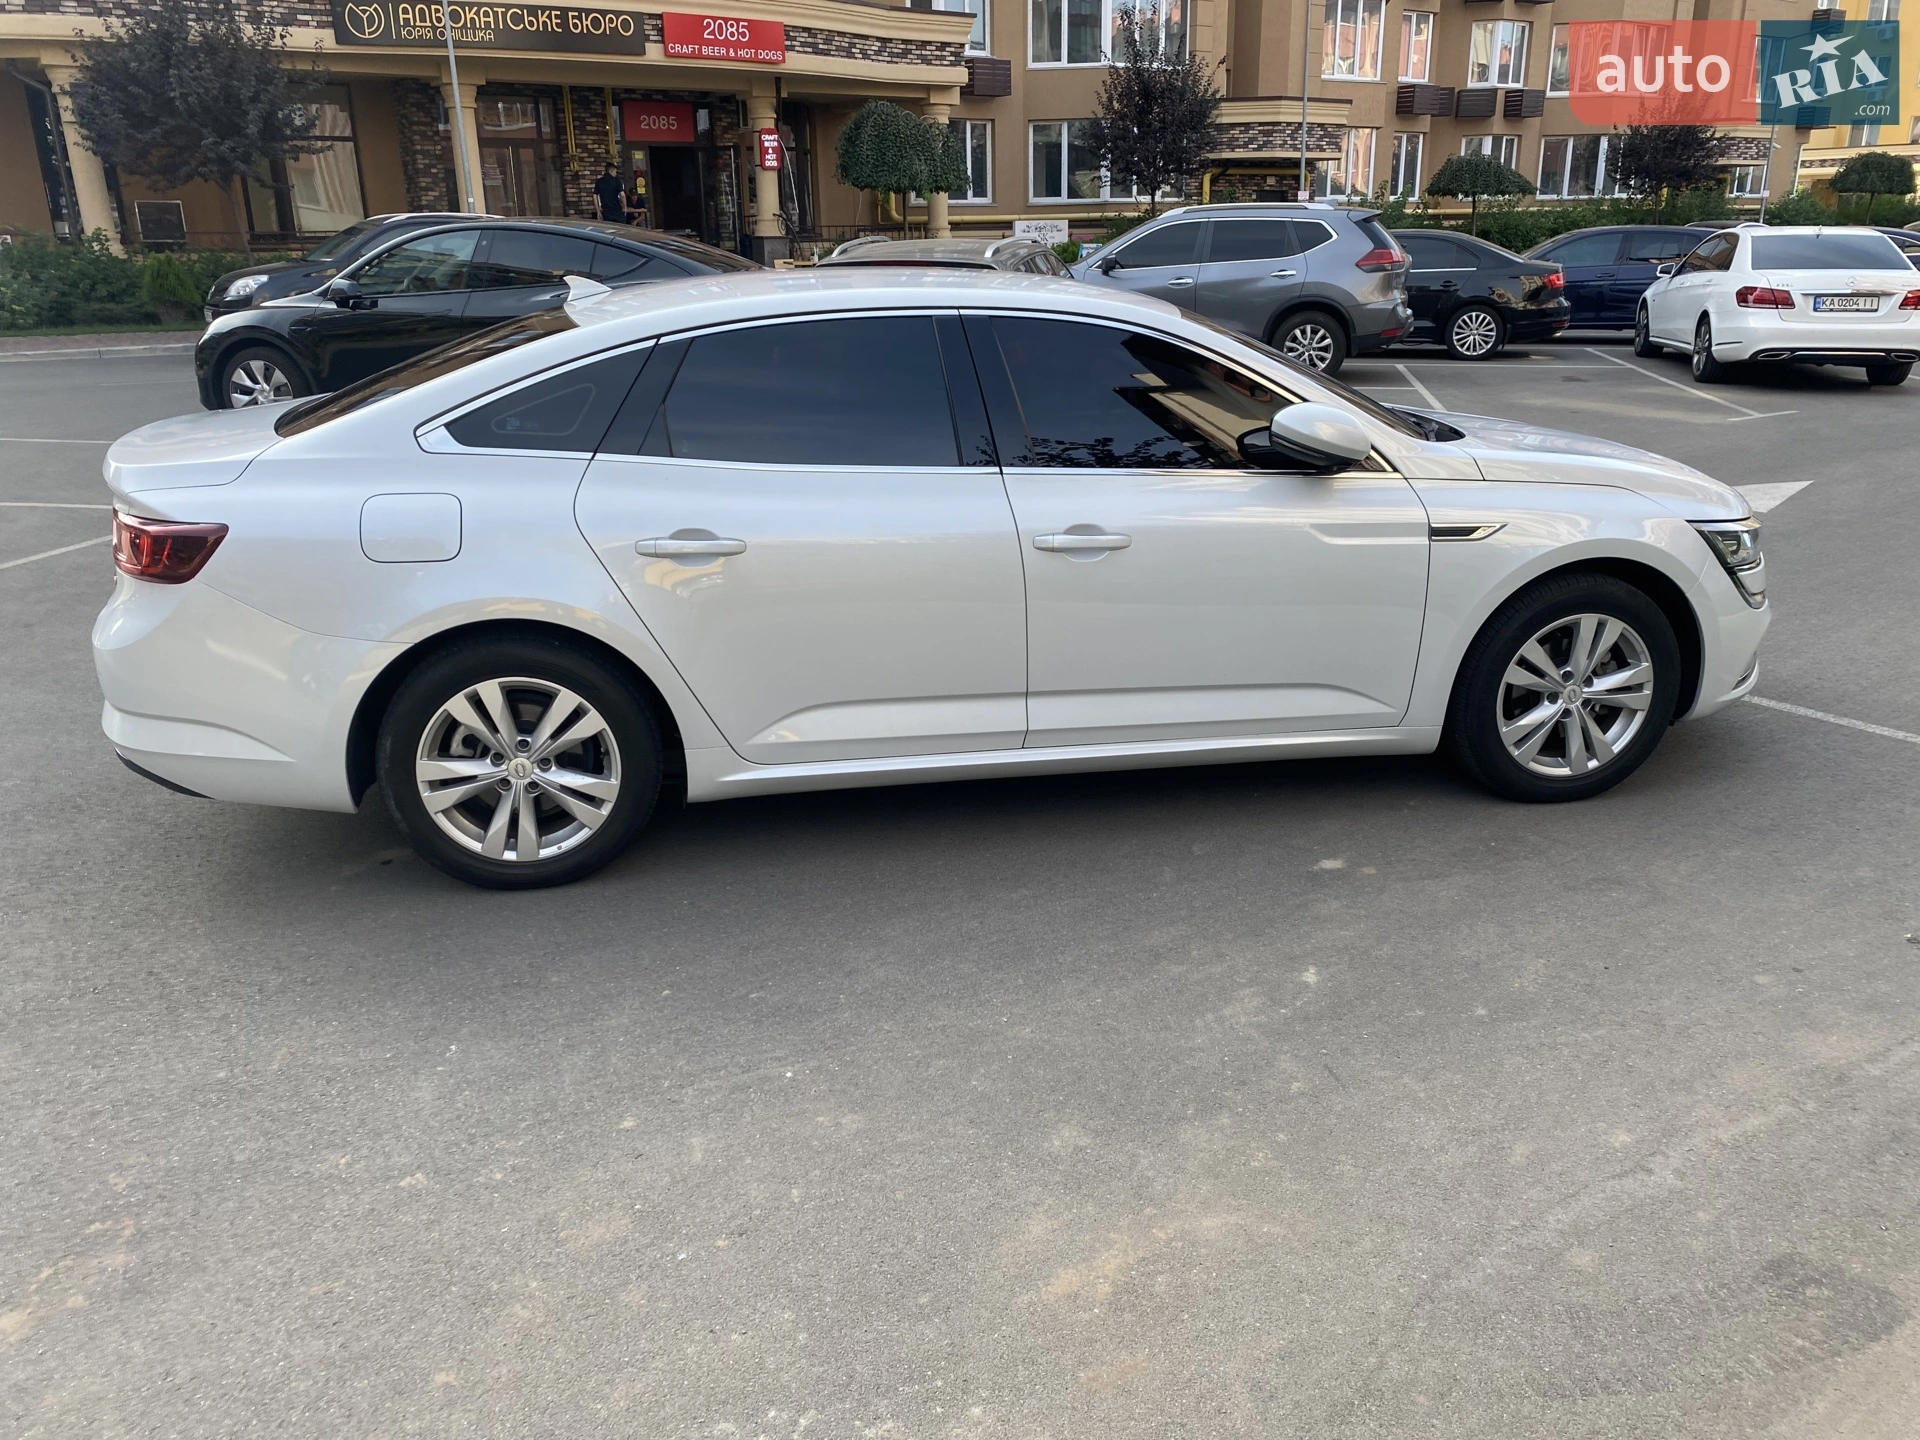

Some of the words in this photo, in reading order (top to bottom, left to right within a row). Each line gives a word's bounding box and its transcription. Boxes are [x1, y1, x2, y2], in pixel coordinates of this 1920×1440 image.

[398, 3, 563, 33] АДВОКАТСЬКЕ
[567, 11, 635, 37] БЮРО
[400, 26, 434, 40] ЮРІЯ
[703, 18, 750, 42] 2085
[668, 43, 700, 55] CRAFT
[702, 45, 727, 57] BEER
[729, 47, 735, 57] &
[737, 48, 756, 58] HOT
[758, 49, 783, 60] DOGS
[640, 115, 678, 130] 2085
[1821, 298, 1836, 308] KA
[1838, 298, 1860, 308] 0204
